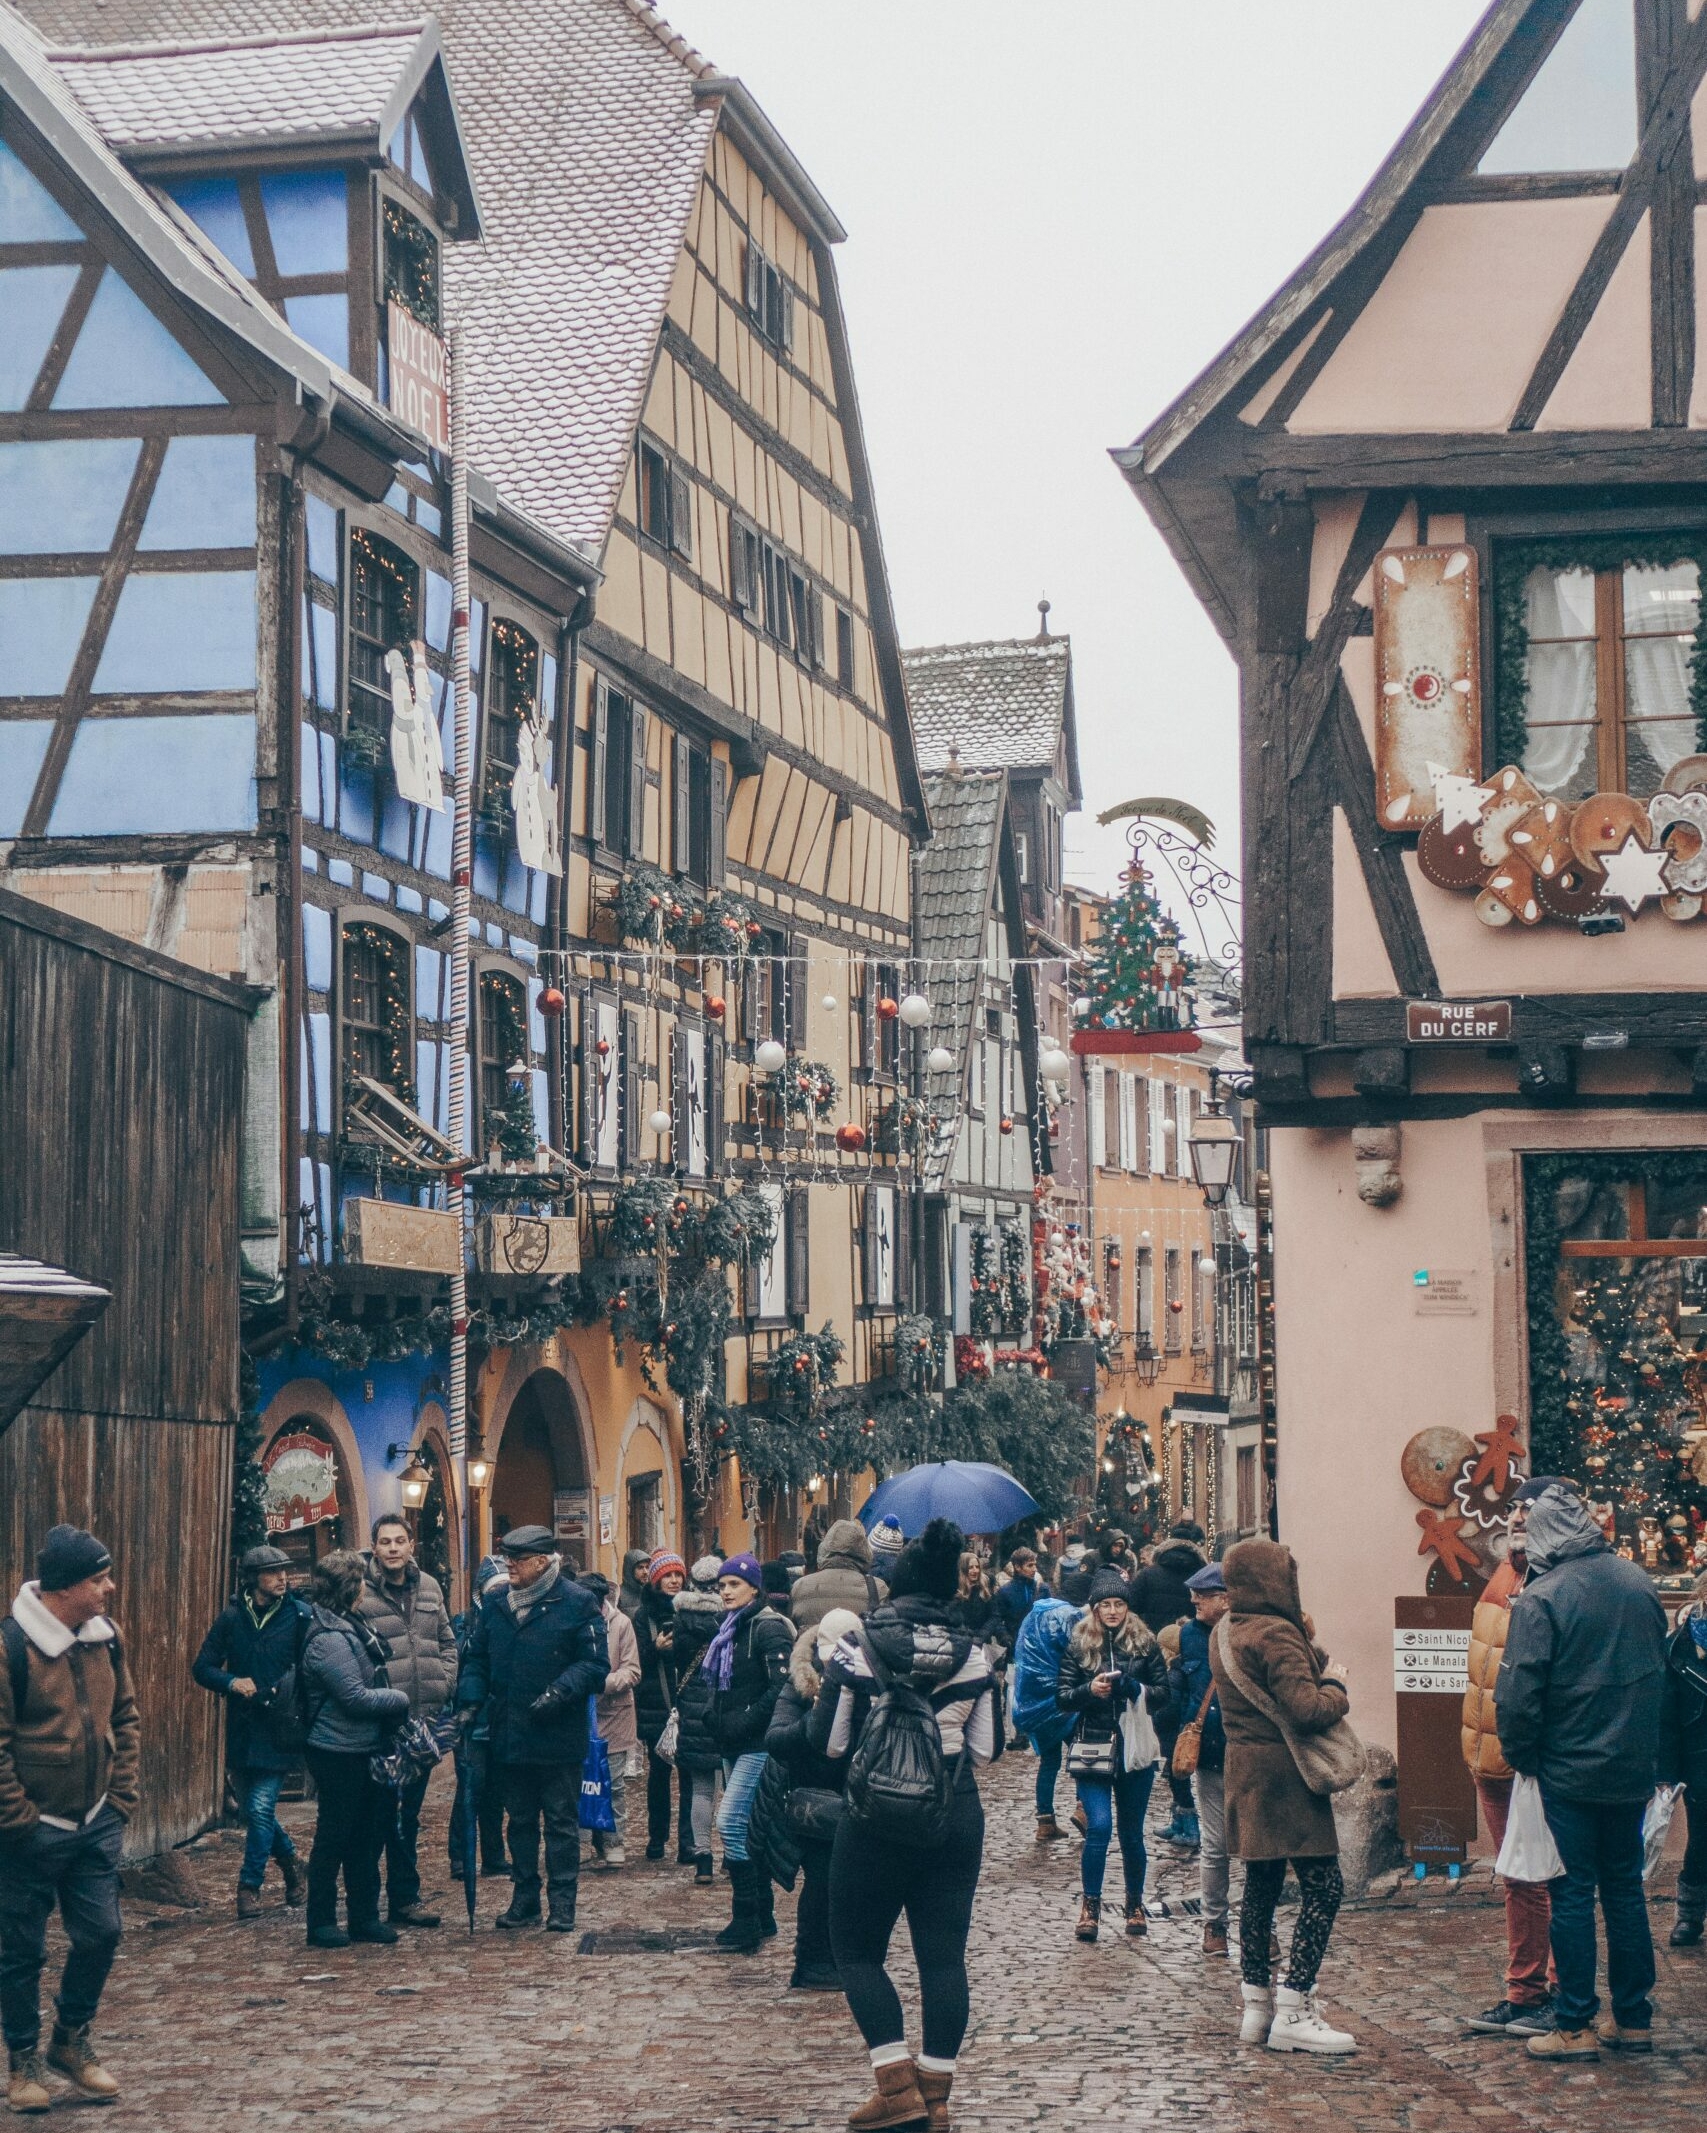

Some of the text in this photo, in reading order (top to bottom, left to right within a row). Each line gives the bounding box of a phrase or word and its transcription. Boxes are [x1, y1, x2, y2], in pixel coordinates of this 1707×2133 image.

[391, 308, 447, 391] JOYEUX
[1155, 804, 1166, 815] de
[1442, 1006, 1475, 1019] RUE
[1420, 1022, 1499, 1036] DU CERF
[266, 1515, 286, 1530] DEPUIS
[1417, 1633, 1443, 1645] Saint
[1417, 1655, 1466, 1666] Le Manala
[1435, 1677, 1446, 1688] Le
